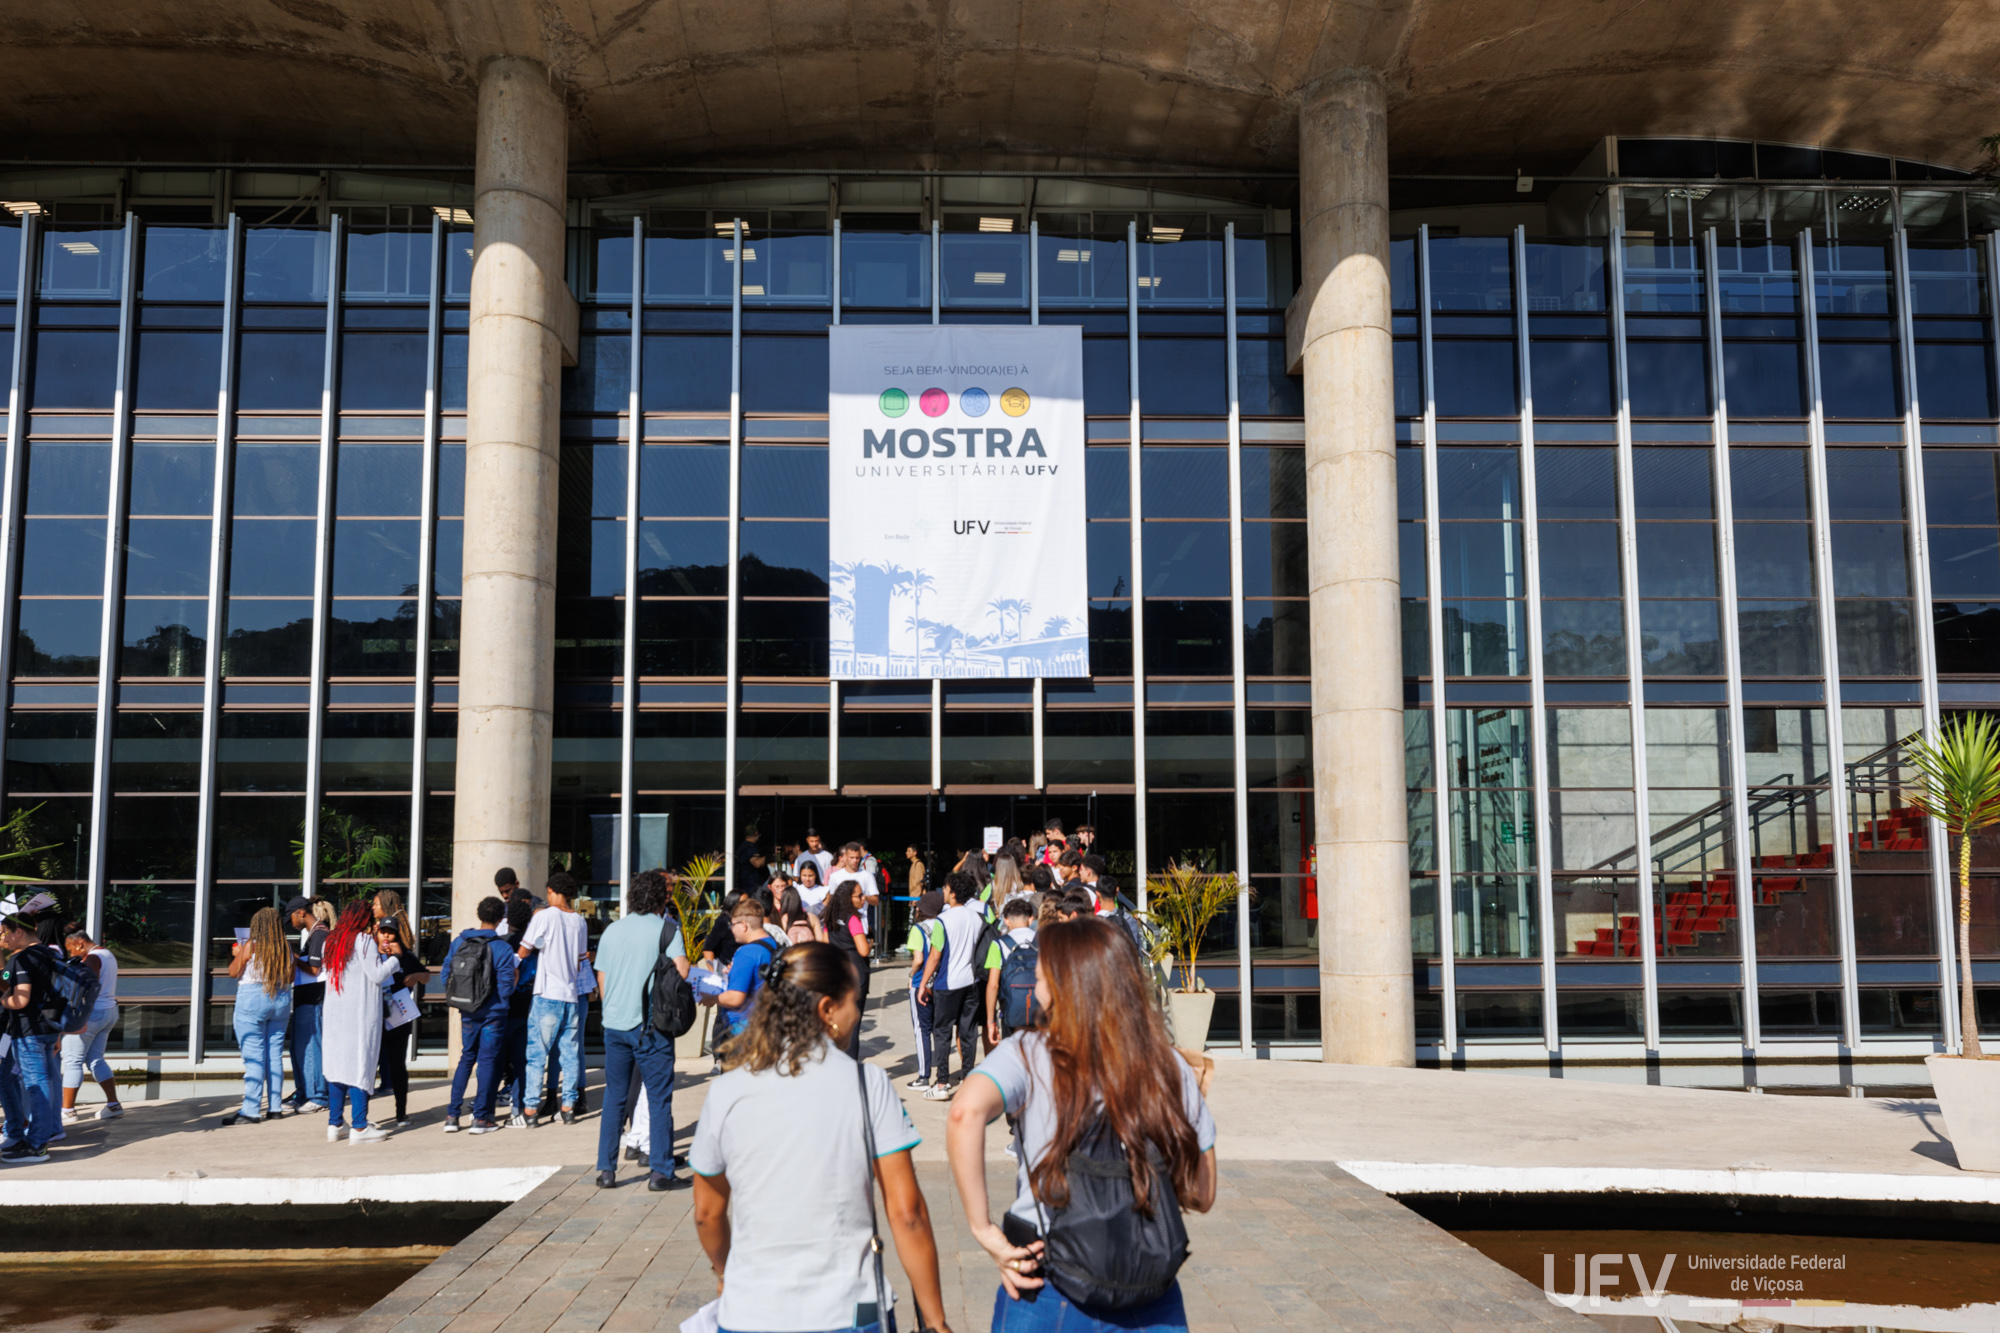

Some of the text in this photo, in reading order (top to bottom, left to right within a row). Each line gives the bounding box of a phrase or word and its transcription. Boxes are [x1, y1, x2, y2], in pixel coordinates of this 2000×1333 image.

[884, 363, 1029, 376] SEJA BEM-VINDO(A)(E) À
[863, 427, 1048, 459] MOSTRA
[855, 462, 1058, 477] UNIVERSITÁRIA UFV
[953, 520, 991, 535] UFV
